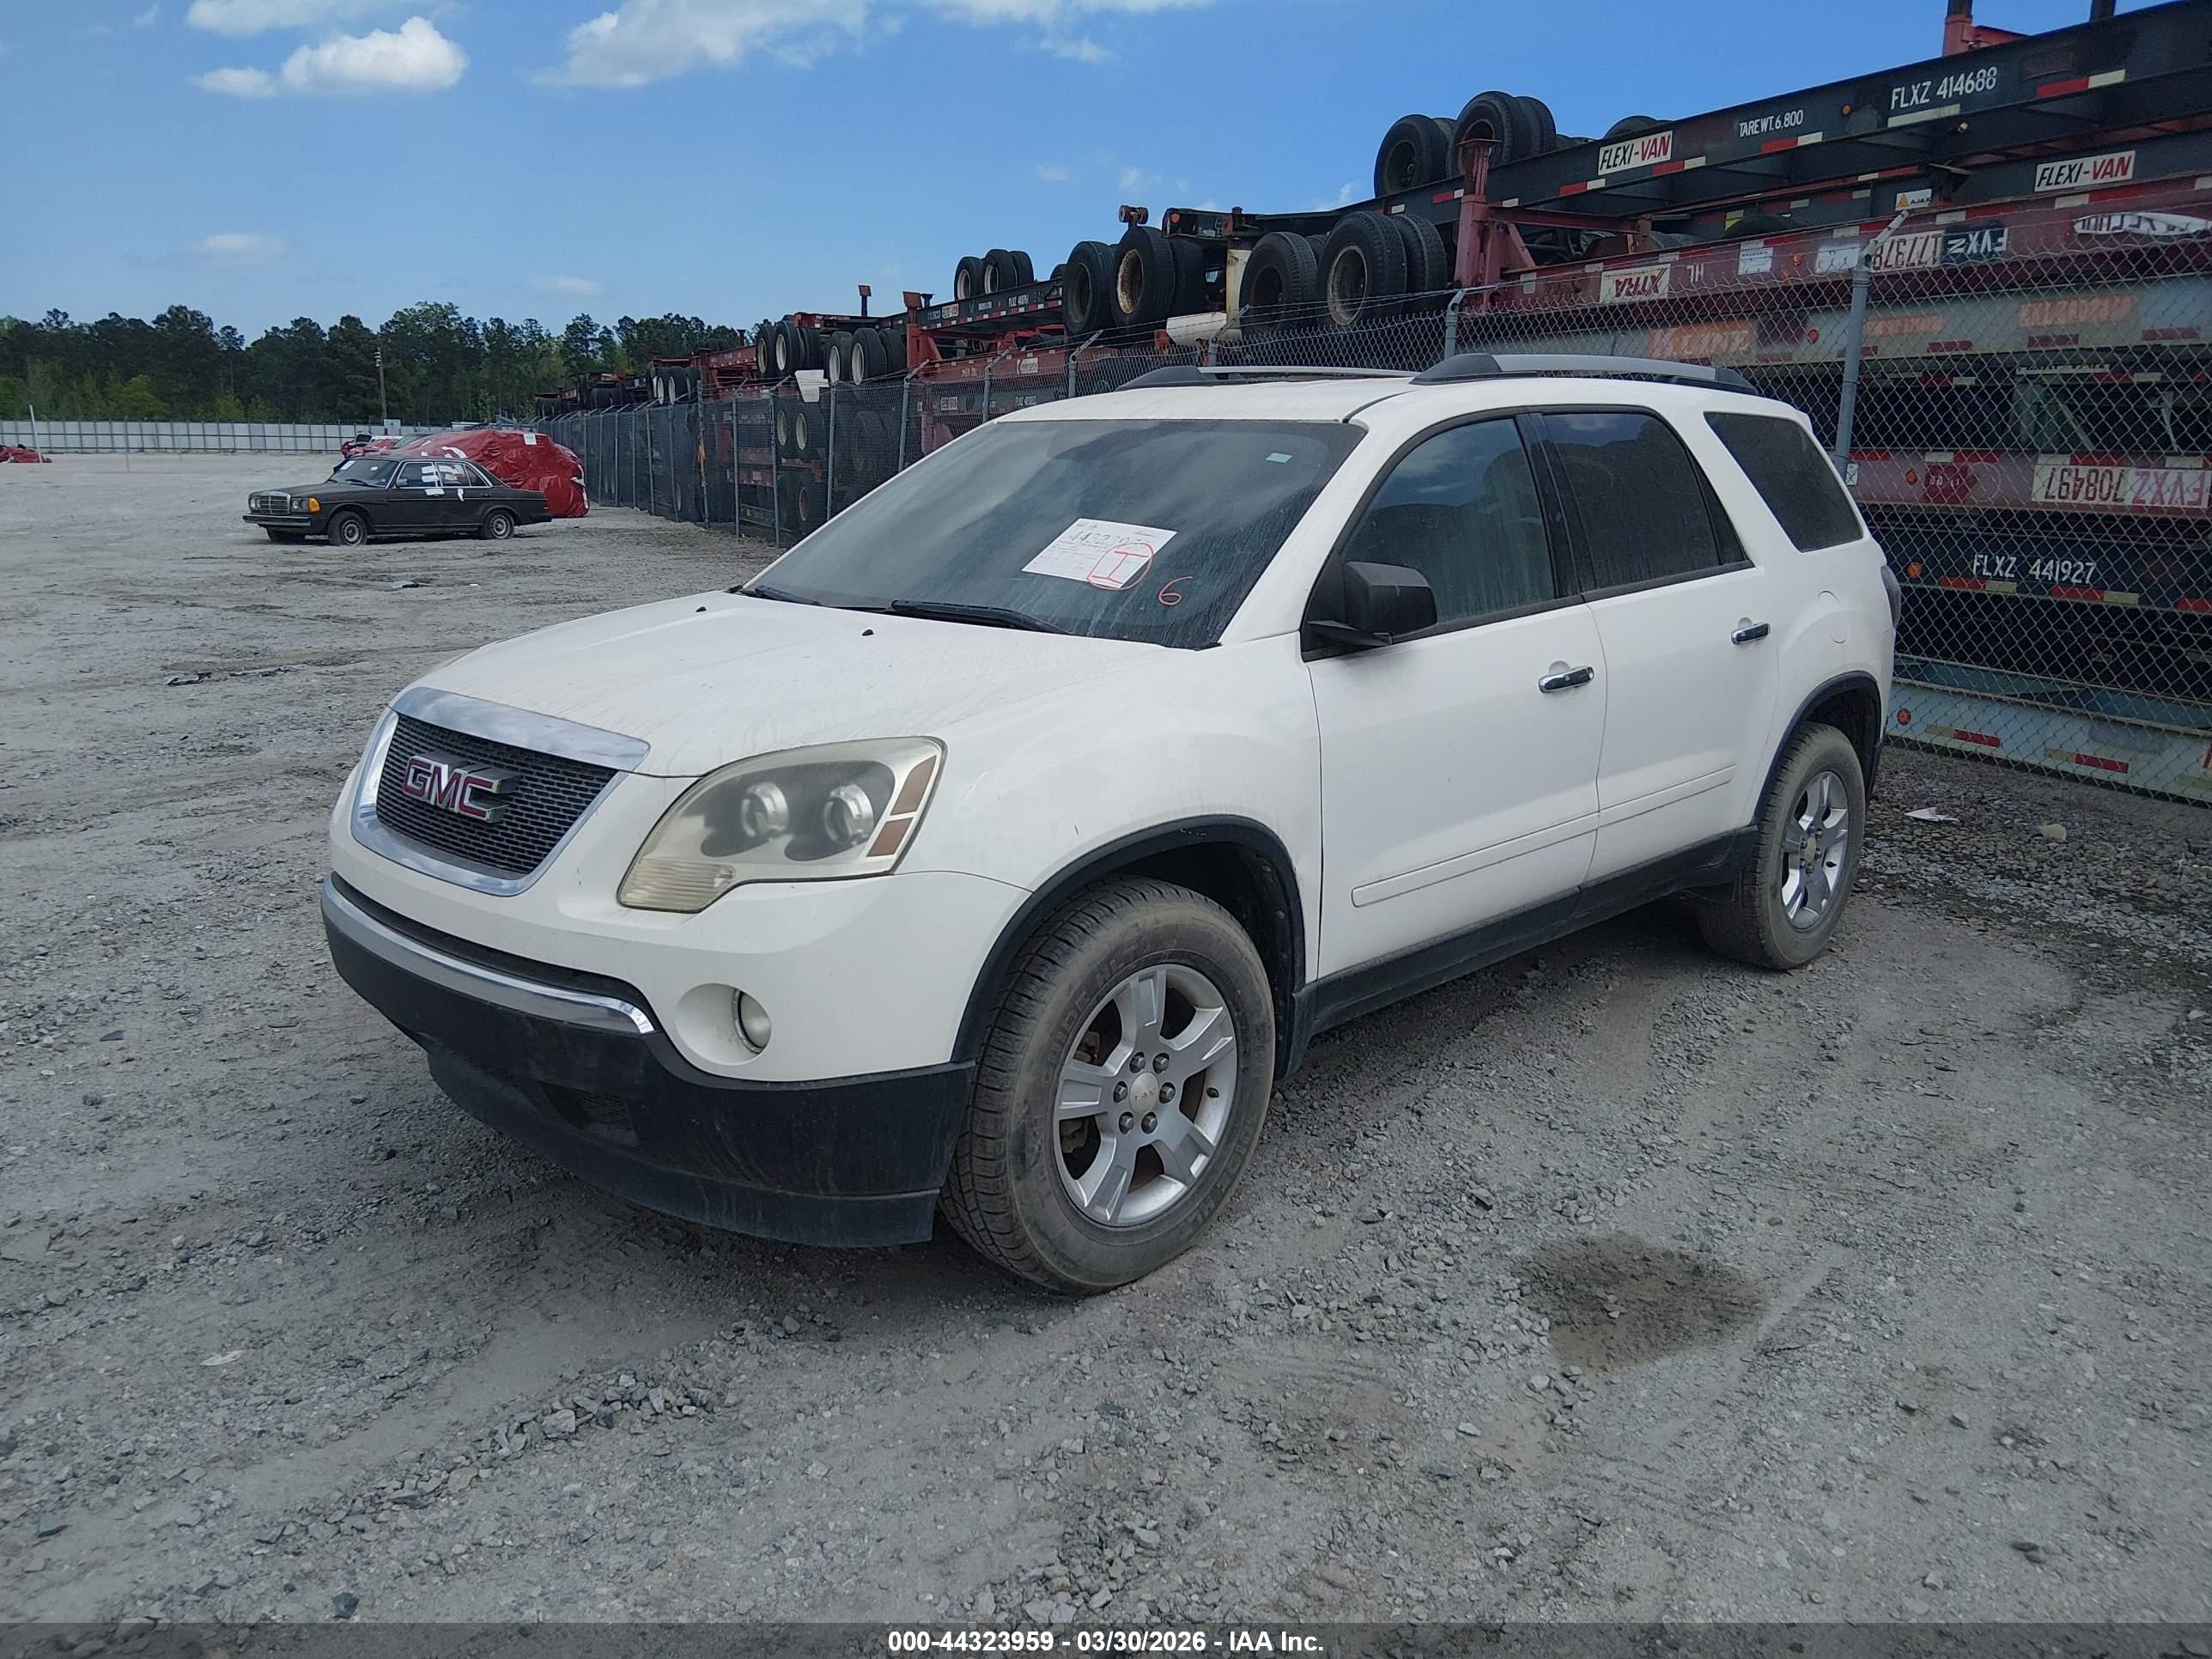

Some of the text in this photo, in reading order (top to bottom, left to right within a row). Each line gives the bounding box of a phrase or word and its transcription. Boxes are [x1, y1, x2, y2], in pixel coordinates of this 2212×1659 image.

[1891, 66, 1997, 110] FLXZ 414688
[1600, 134, 1671, 171] FLEXI-VAN
[2036, 155, 2132, 188] FLEXI-VAN
[1948, 227, 2008, 255] FVXZ
[1614, 268, 1667, 298] XTRA
[2045, 467, 2205, 506] FVXZ 708497
[1972, 554, 2097, 585] FLXZ 441927
[1158, 576, 1194, 605] 6
[401, 754, 508, 823] GMC
